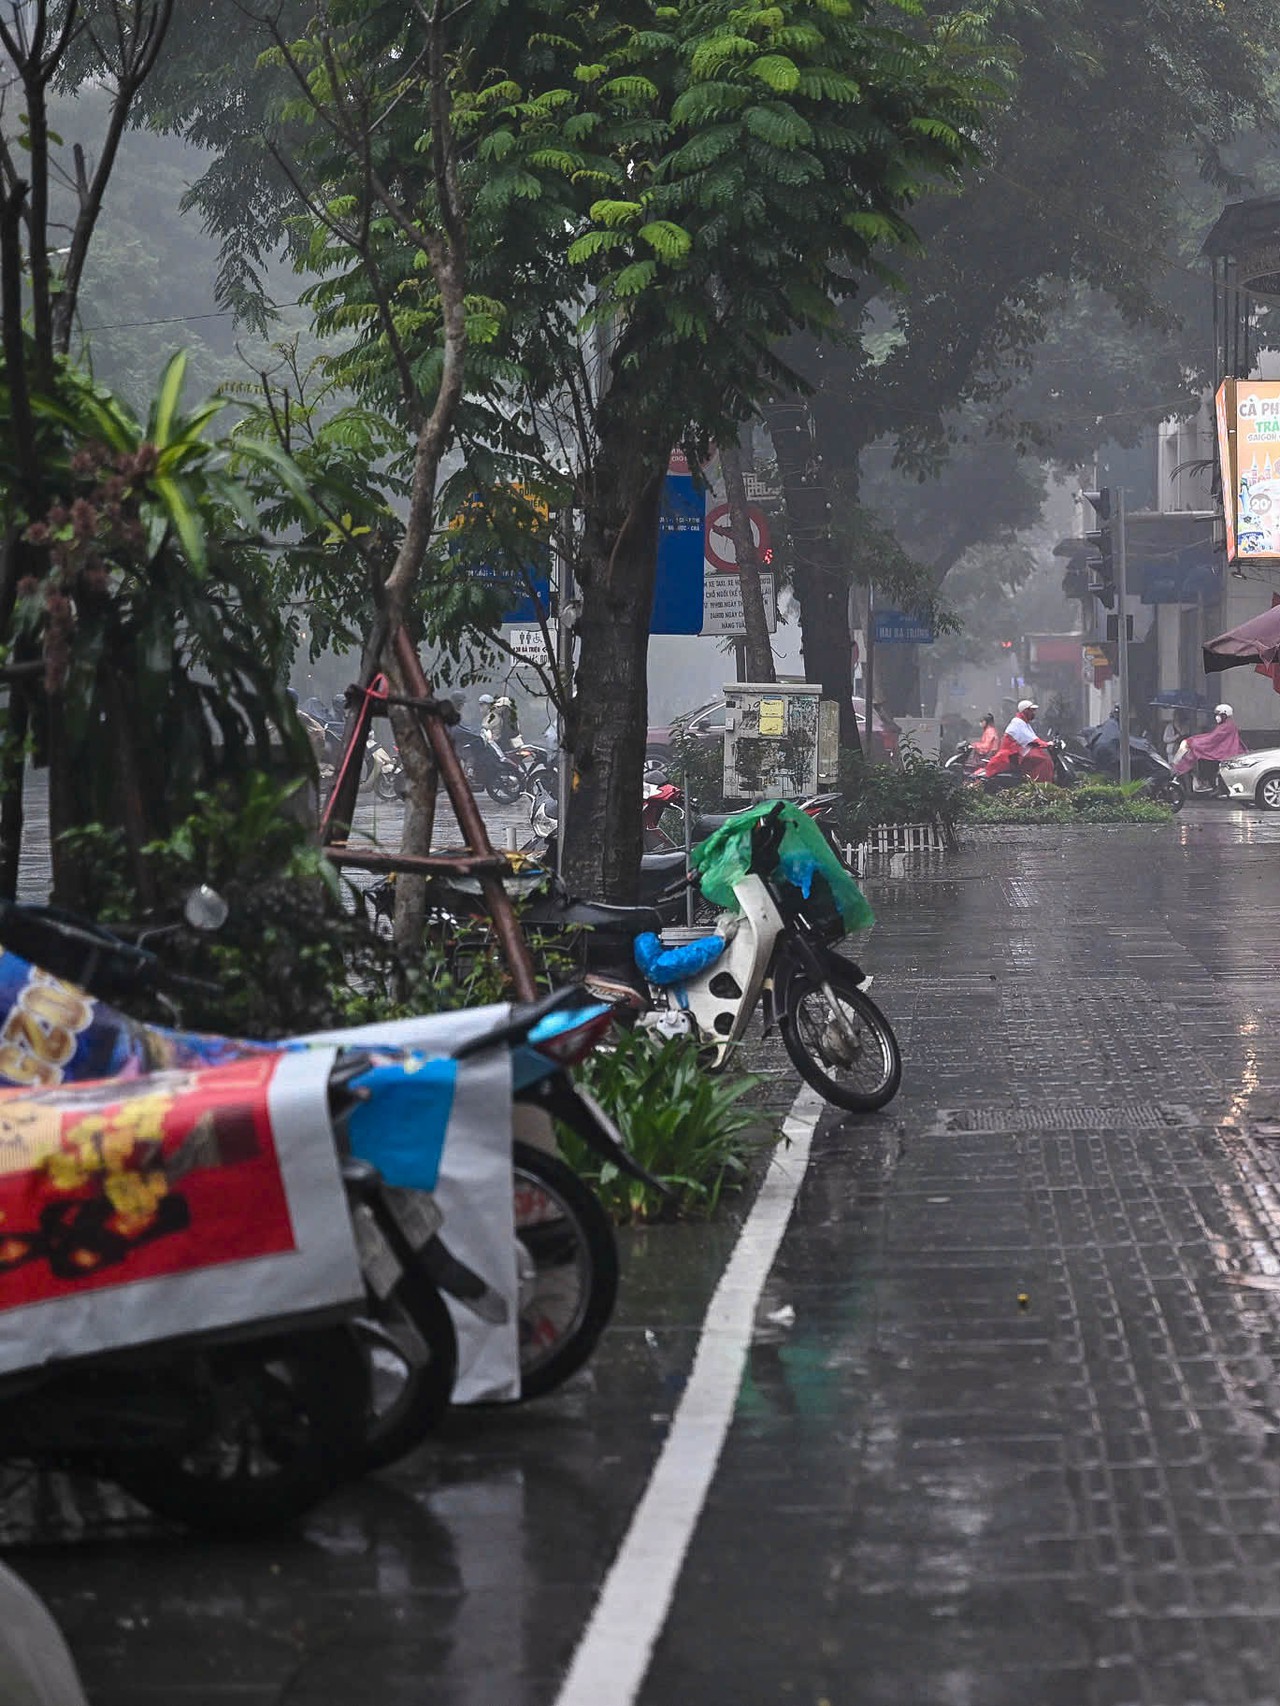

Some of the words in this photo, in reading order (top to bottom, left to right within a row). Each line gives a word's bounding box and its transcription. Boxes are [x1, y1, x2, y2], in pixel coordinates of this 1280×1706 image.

[1239, 398, 1257, 417] CÀ
[1256, 416, 1280, 433] TRÀ
[1248, 432, 1277, 441] SAIGON
